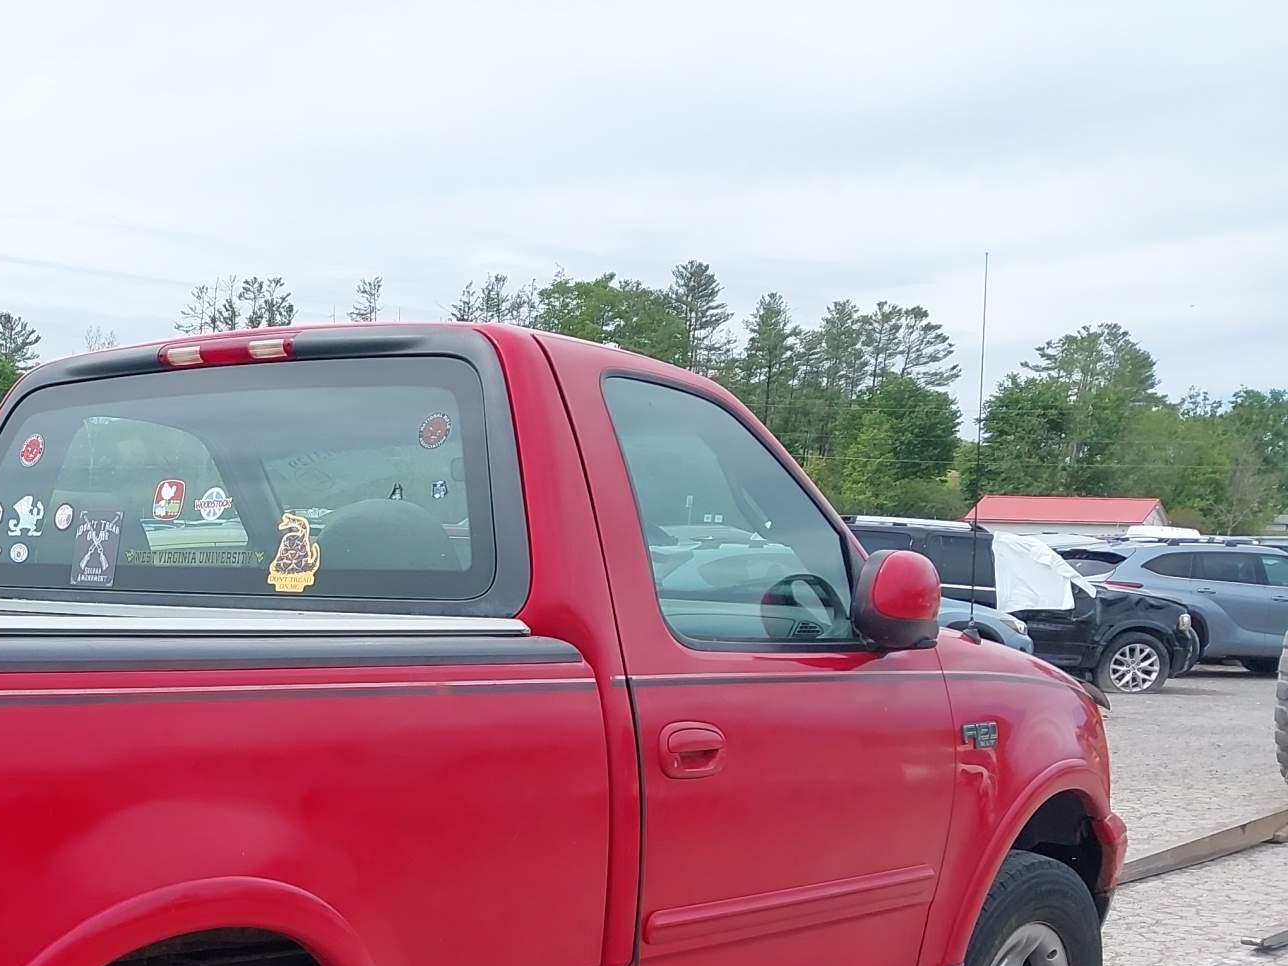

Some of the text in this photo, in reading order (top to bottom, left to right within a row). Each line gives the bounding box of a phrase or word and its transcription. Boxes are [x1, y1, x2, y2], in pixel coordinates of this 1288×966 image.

[135, 551, 157, 564] WEST
[158, 551, 197, 564] VIRGINIA
[199, 551, 253, 564] UNIVERSITY
